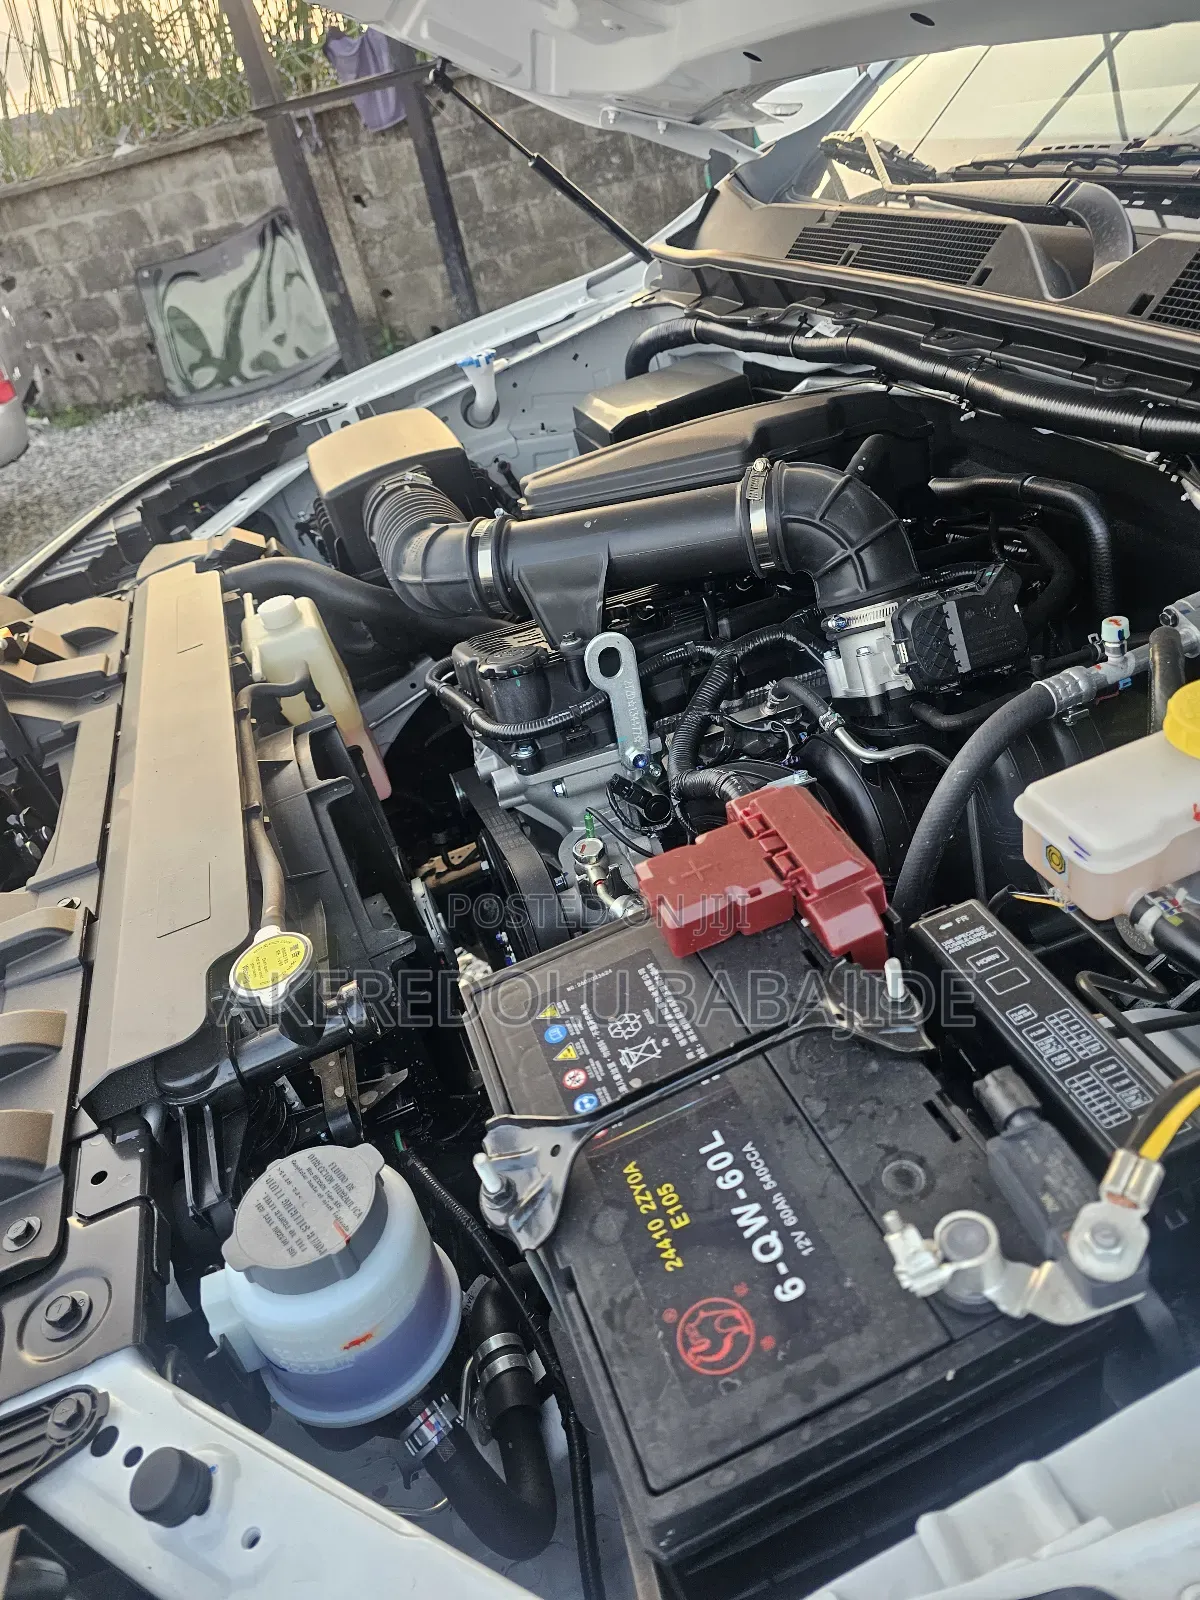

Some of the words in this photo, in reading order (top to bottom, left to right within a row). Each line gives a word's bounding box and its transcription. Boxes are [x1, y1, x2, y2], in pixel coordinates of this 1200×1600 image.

[955, 914, 970, 924] FR
[741, 1140, 778, 1191] 540CCA
[281, 1198, 312, 1233] STEERING
[656, 1183, 691, 1230] E105
[698, 1129, 807, 1302] 6-QW-60L
[771, 1192, 799, 1227] 60Ah
[307, 1230, 329, 1256] POWER
[647, 1217, 685, 1272] 24410
[790, 1230, 816, 1256] 12V
